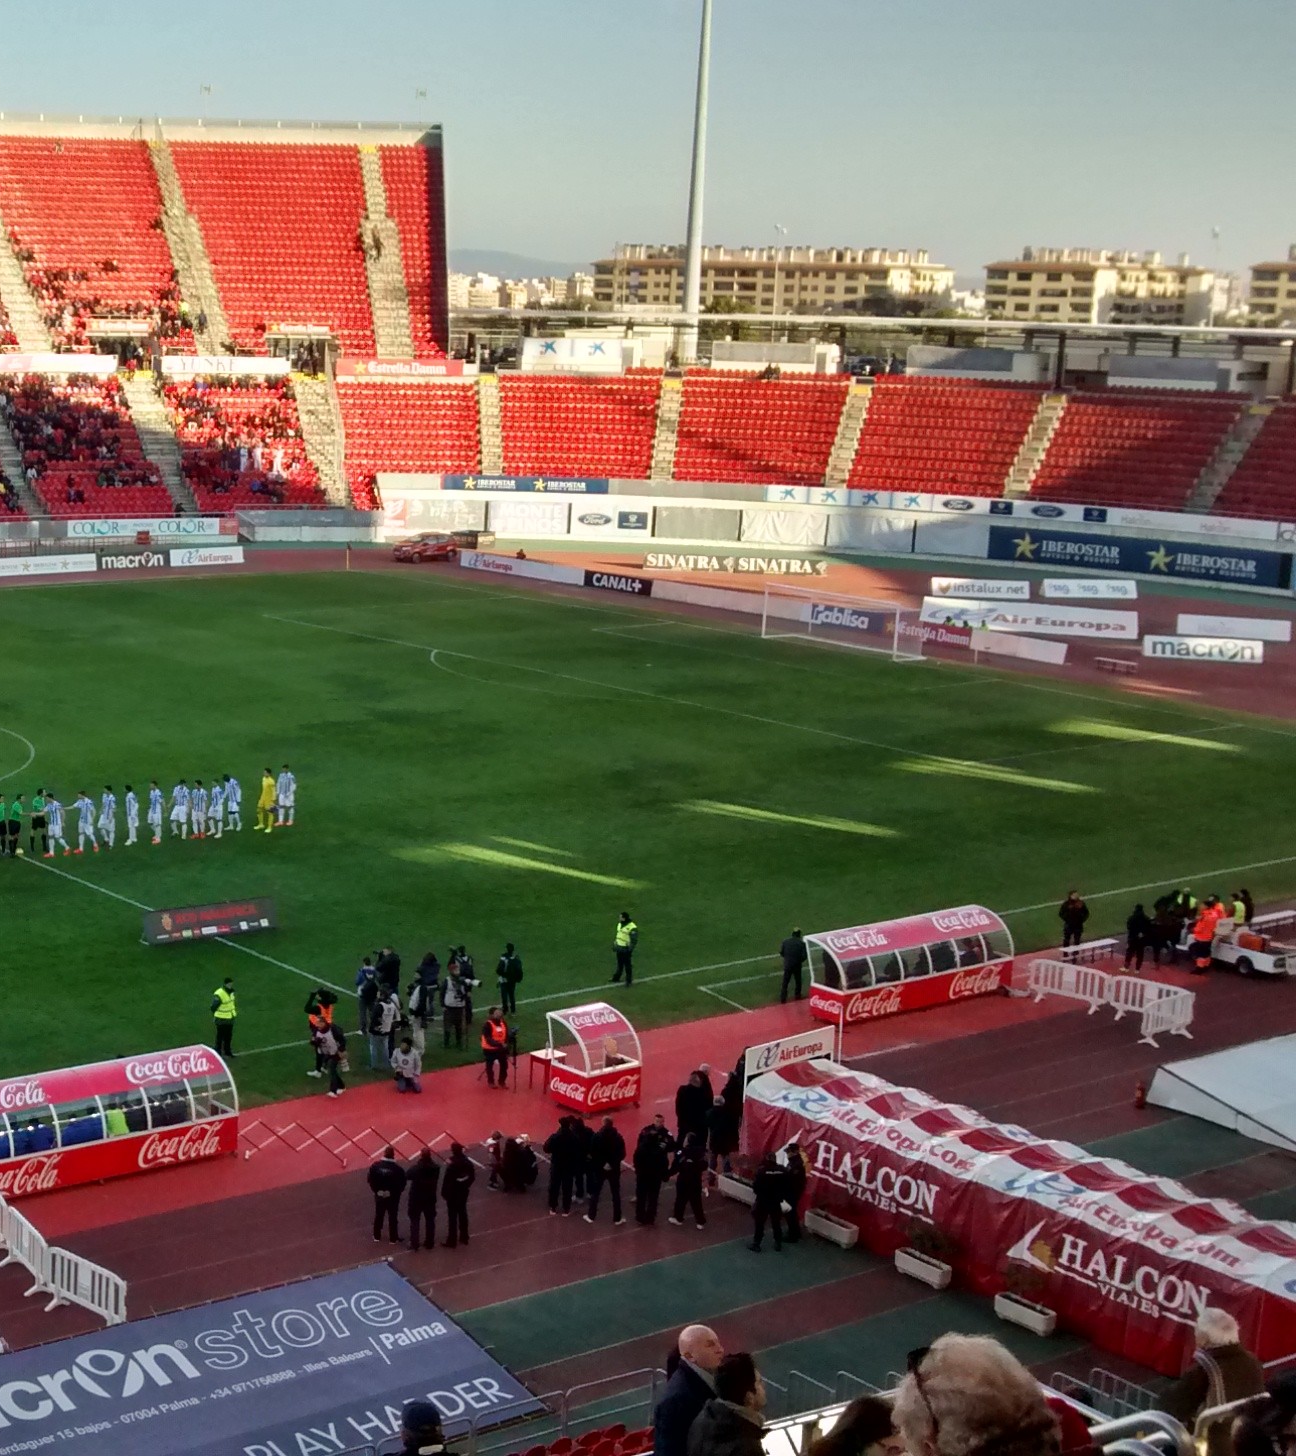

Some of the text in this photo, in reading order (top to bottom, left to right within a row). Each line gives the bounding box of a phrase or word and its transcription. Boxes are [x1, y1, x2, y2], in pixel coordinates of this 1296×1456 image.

[368, 361, 446, 375] Estrella Damm
[1042, 540, 1120, 558] IBEROSTAR
[102, 552, 163, 569] macron
[647, 553, 720, 570] SINATRA
[738, 557, 812, 573] SINATRA
[1176, 552, 1256, 572] IBEROSTAR
[592, 573, 642, 592] CANAL+
[1152, 639, 1255, 660] macron
[779, 1040, 823, 1061] AirEuropa
[814, 1139, 939, 1215] HALCON
[846, 1182, 897, 1213] VIAJES
[1059, 1233, 1211, 1315] HALCON
[1097, 1283, 1160, 1317] VIAJES
[194, 1290, 403, 1370] store
[379, 1322, 448, 1350] Palma
[57, 1428, 75, 1440] 15
[74, 1420, 112, 1435] bajos
[120, 1406, 160, 1423] 07004
[159, 1396, 201, 1413] Palma
[209, 1386, 232, 1400] +34
[303, 1360, 330, 1373] Illes
[328, 1349, 373, 1365] Balears
[346, 1377, 515, 1440] HADER
